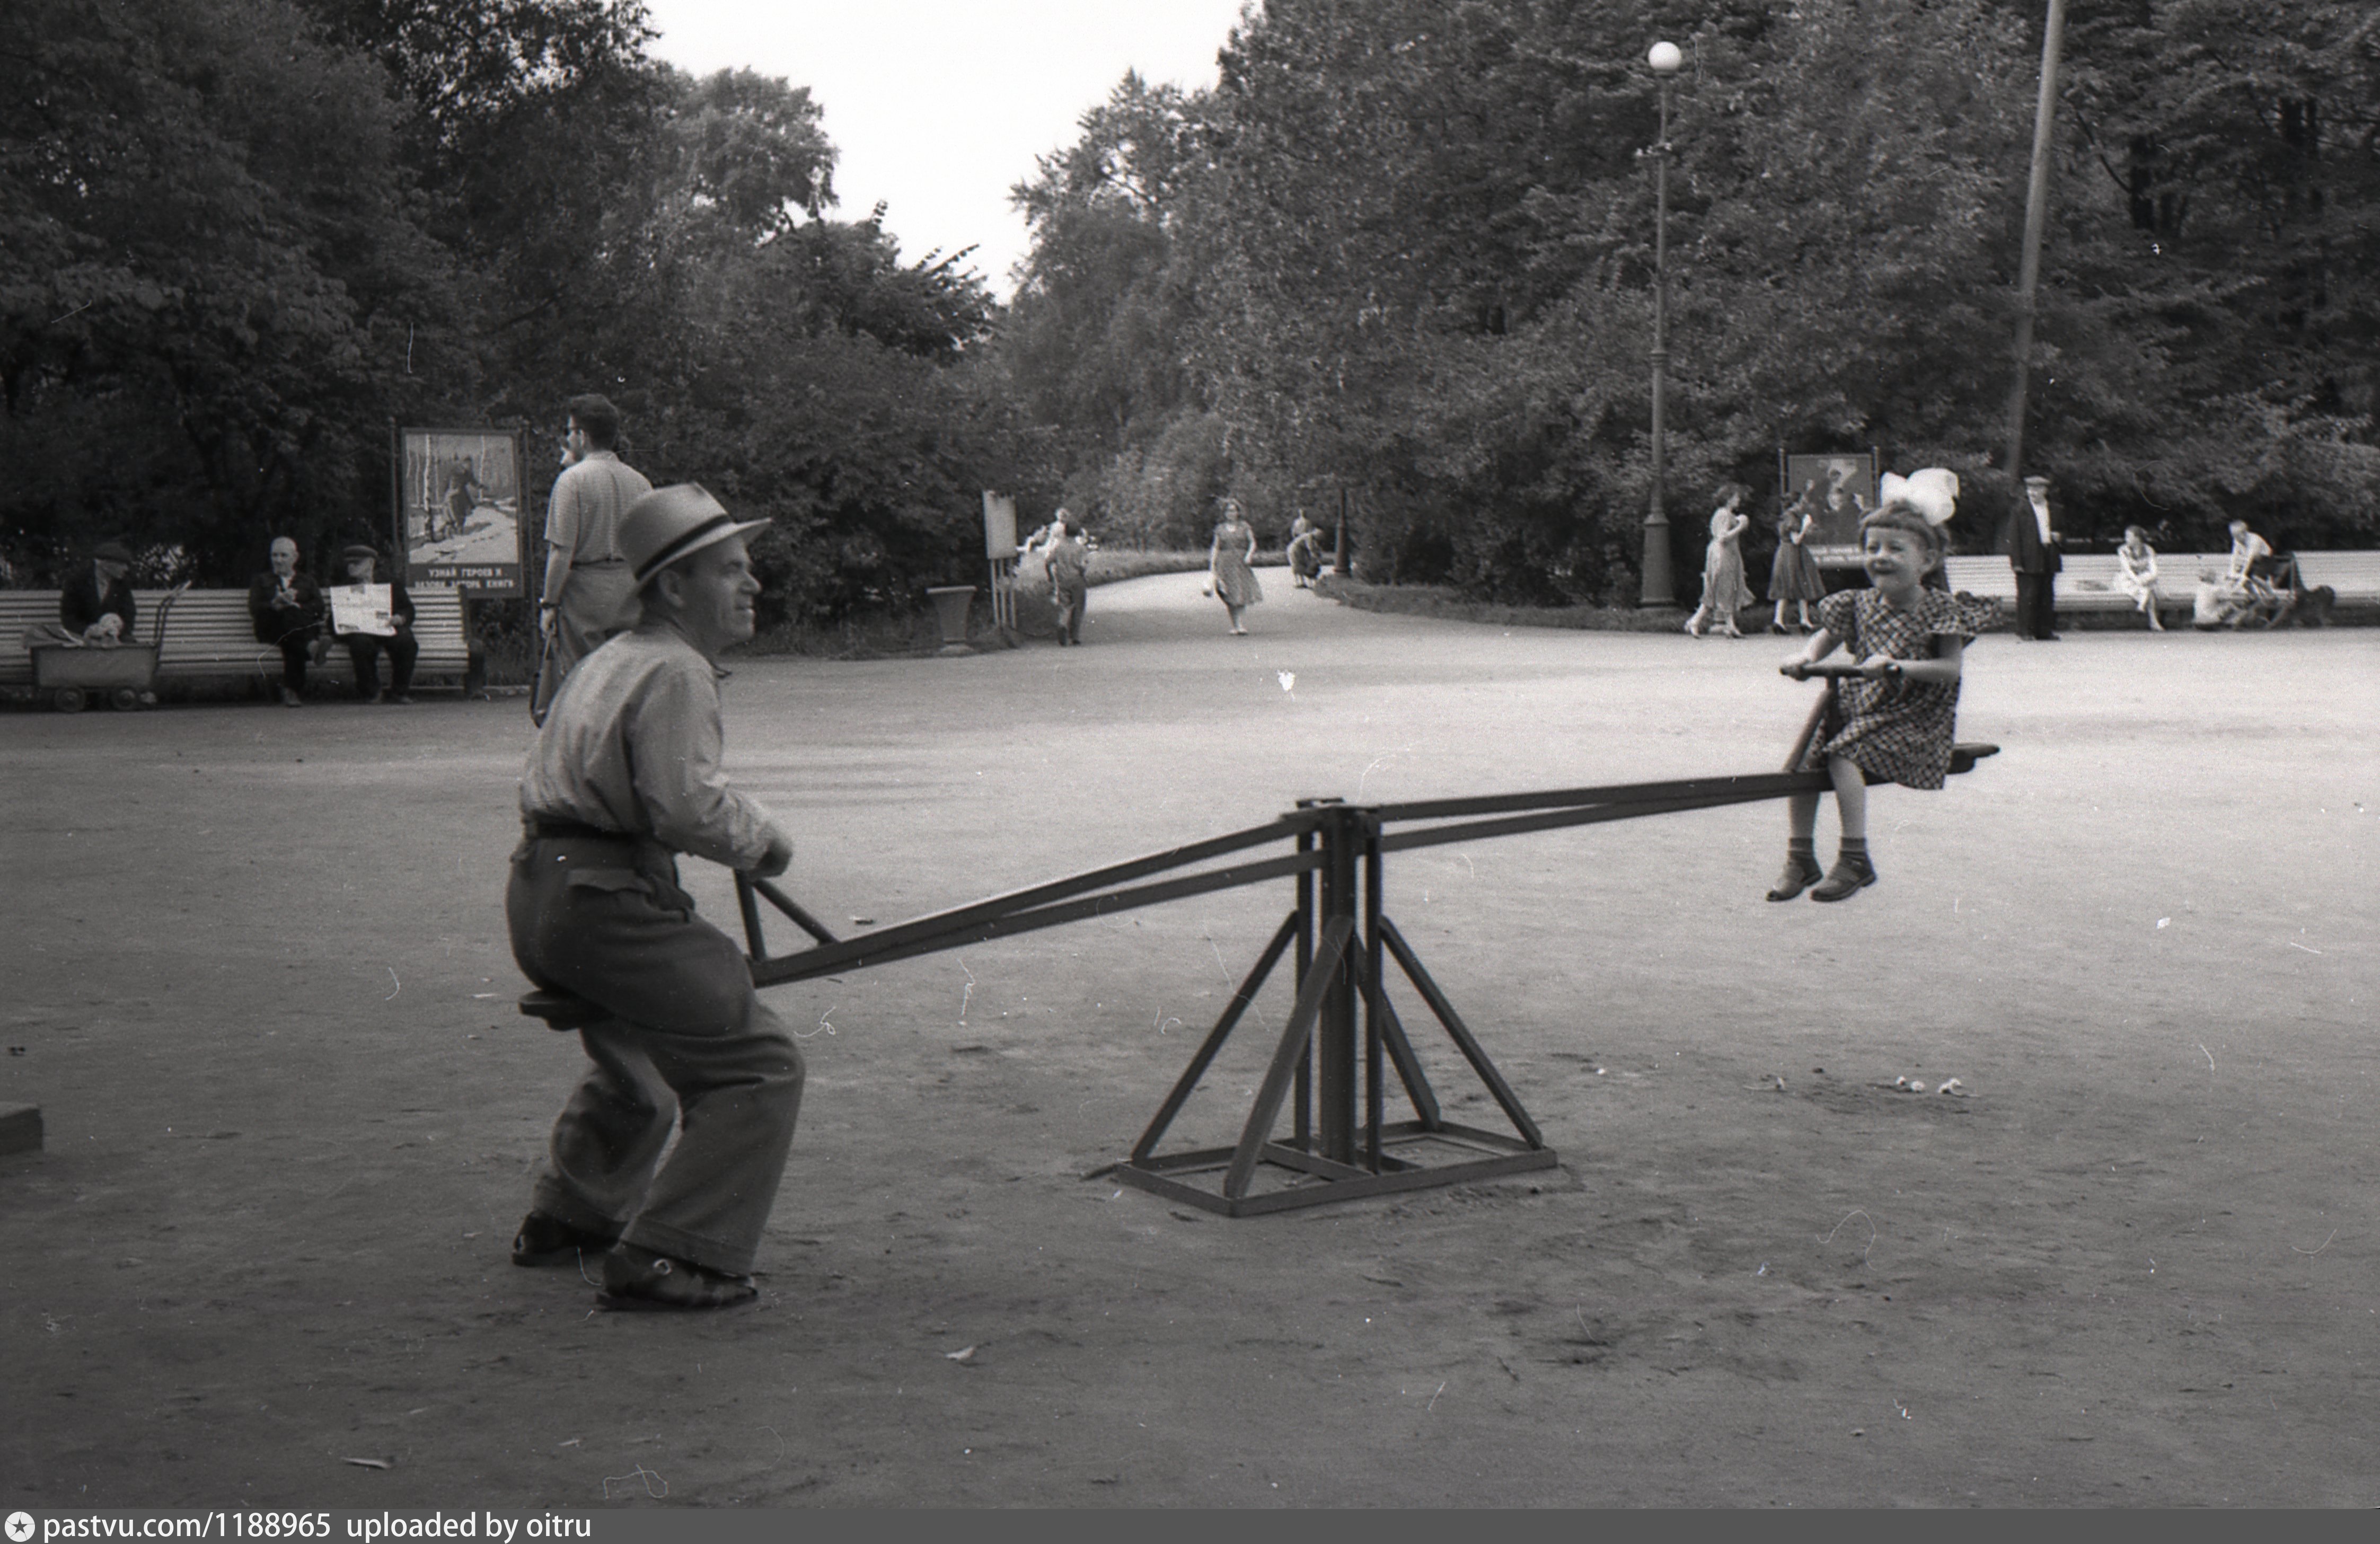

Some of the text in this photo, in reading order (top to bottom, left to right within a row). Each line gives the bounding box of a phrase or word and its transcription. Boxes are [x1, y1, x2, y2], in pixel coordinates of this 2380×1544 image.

[428, 567, 502, 577] УЗНАЙ ГЕРОЕВ И
[486, 579, 514, 588] КНИГИ
